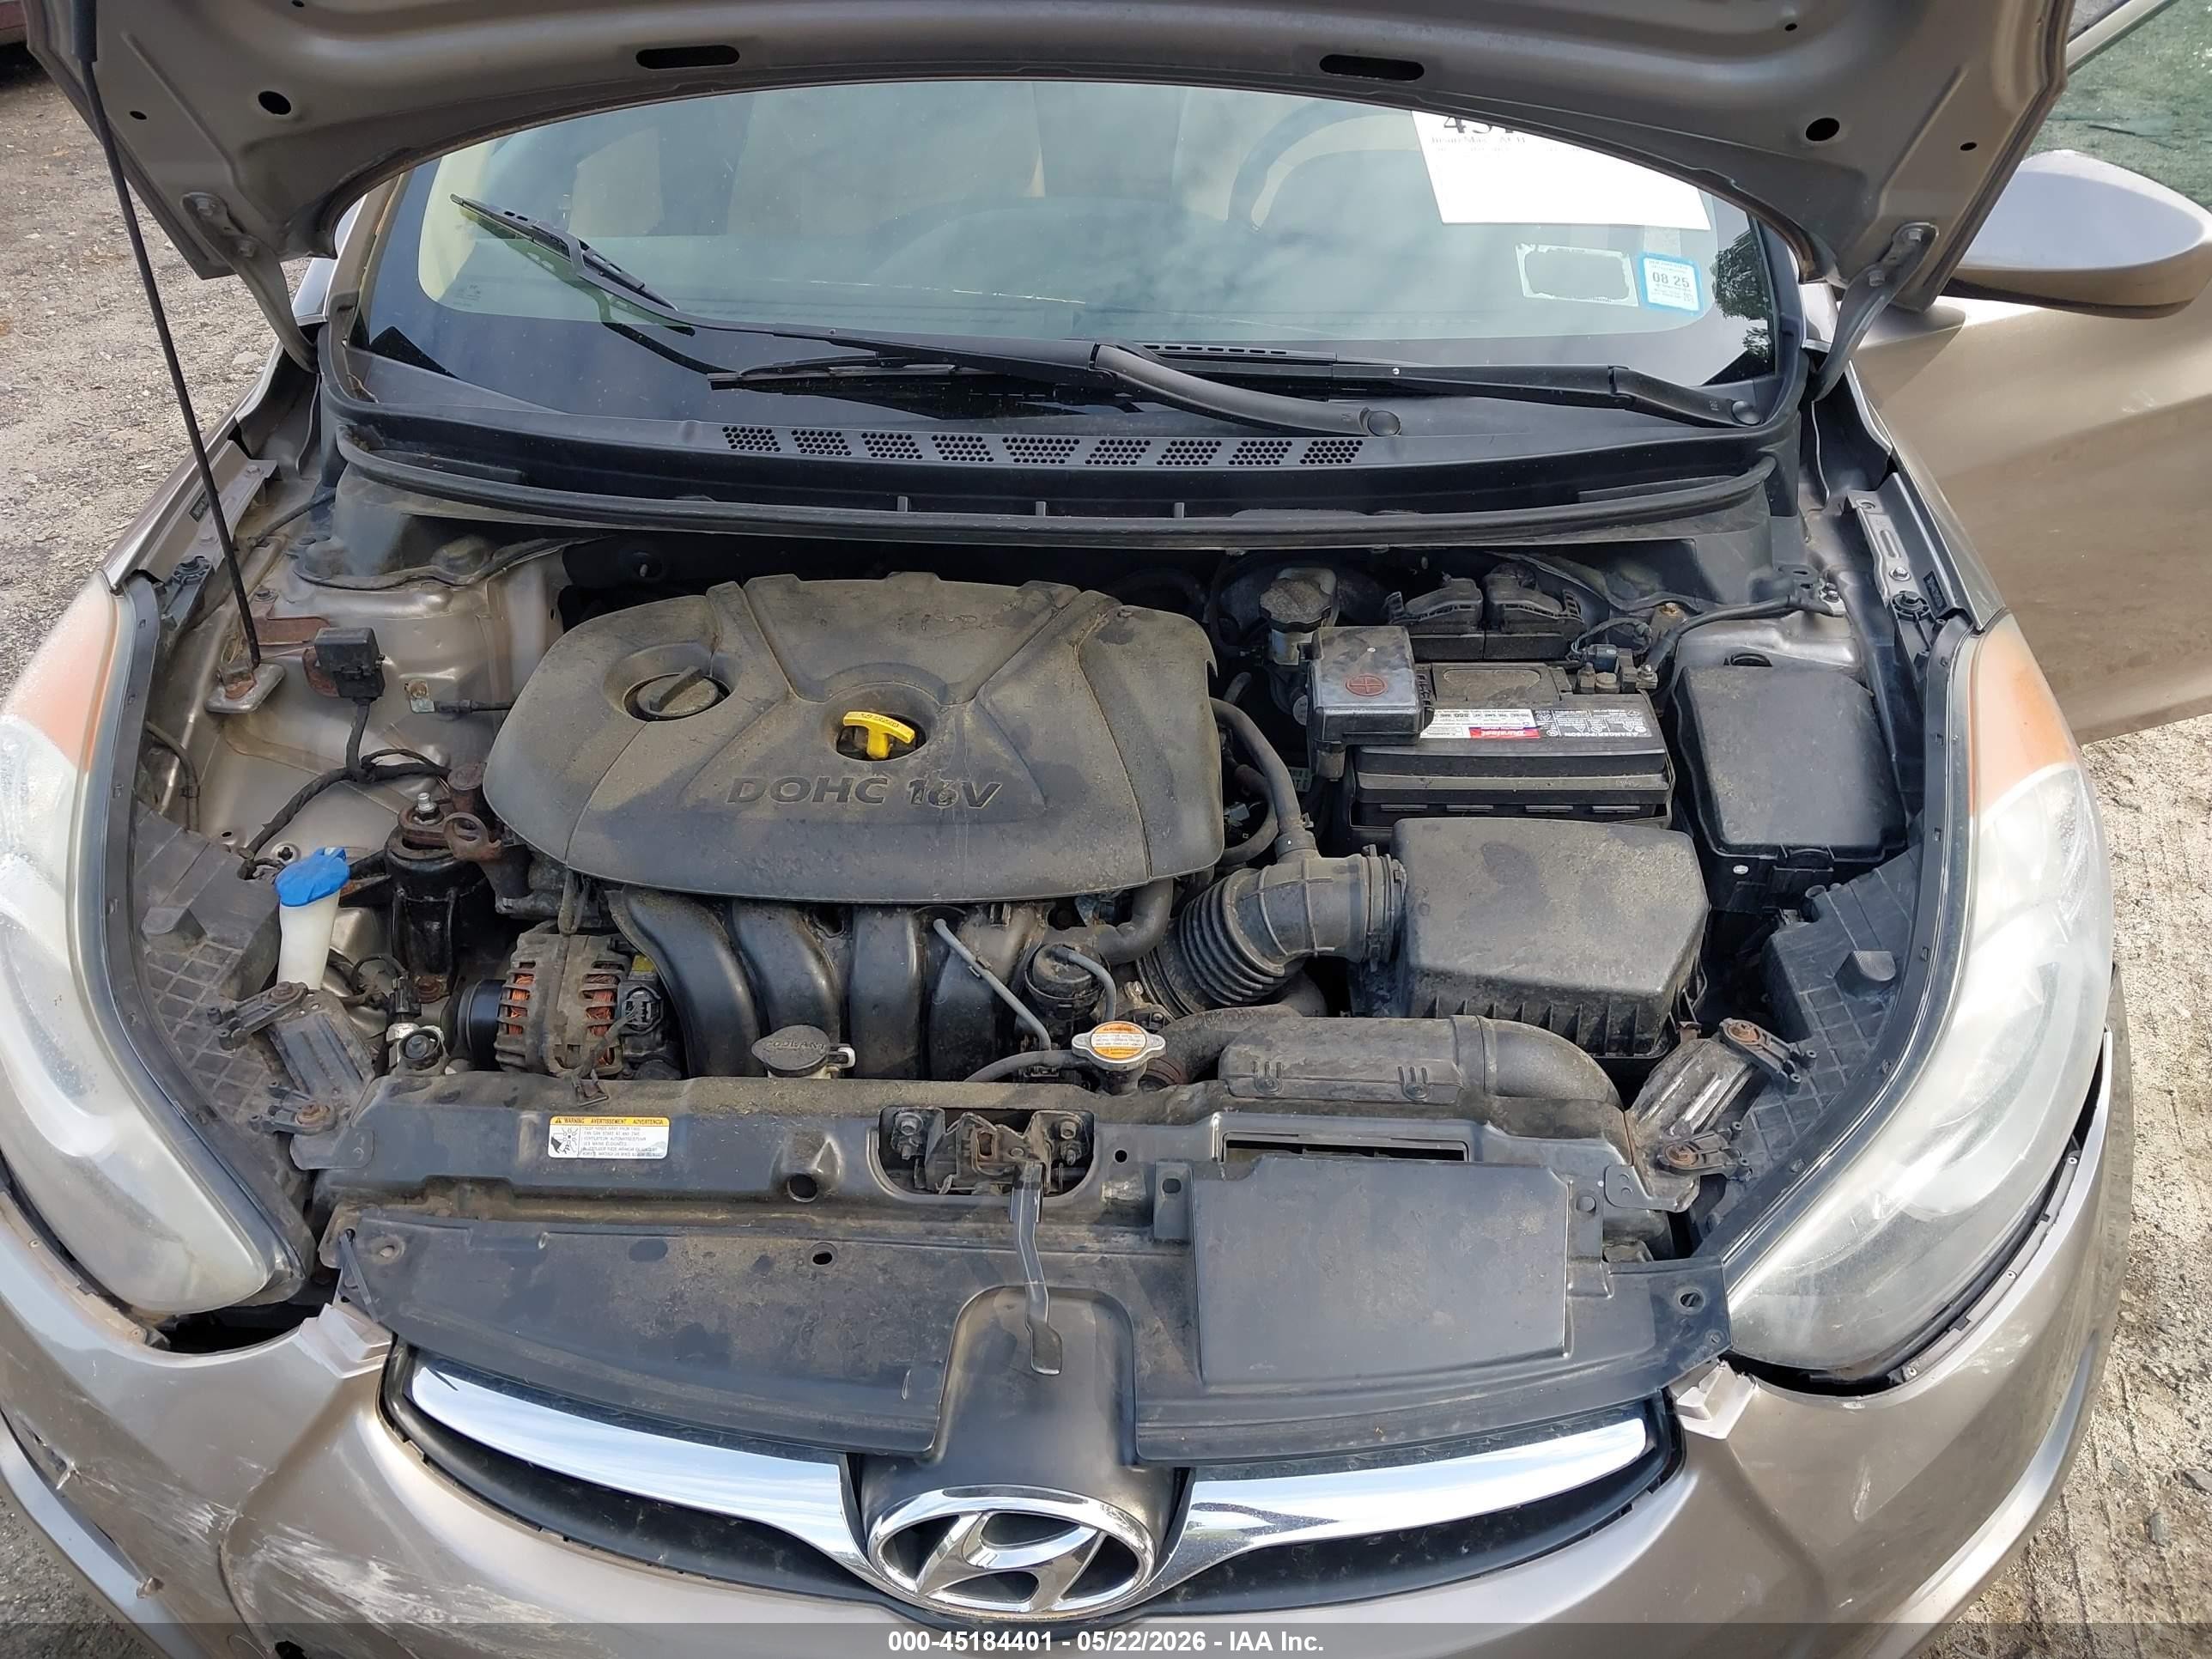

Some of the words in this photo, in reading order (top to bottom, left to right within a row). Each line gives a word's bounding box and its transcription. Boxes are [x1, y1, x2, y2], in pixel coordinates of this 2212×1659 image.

[1652, 271, 1668, 284] 08
[1673, 275, 1690, 288] 25
[726, 775, 888, 805] DOHC
[908, 779, 1002, 809] 16V
